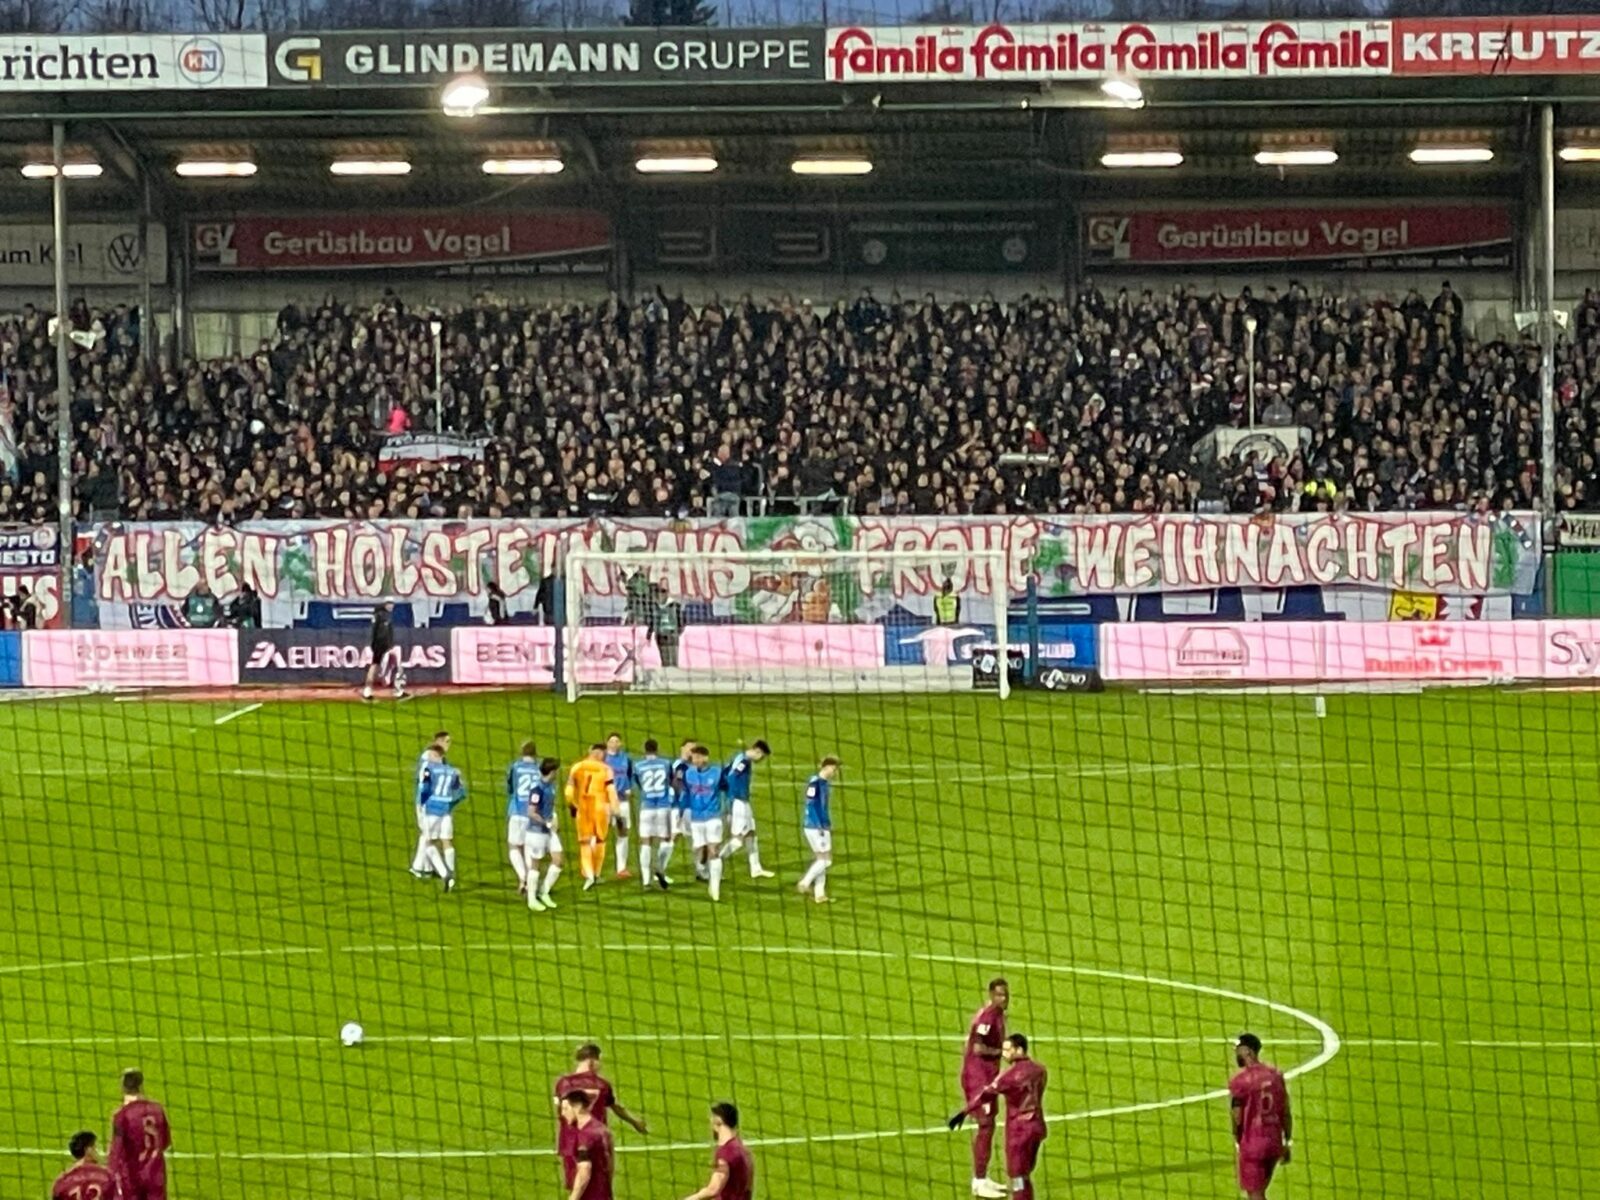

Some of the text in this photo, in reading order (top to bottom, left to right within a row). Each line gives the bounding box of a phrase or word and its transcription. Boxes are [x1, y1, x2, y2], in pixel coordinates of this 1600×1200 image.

[2, 45, 159, 80] richten
[345, 39, 810, 74] GLINDEMANN GRUPPE
[828, 22, 1389, 80] famila famila famila famila
[1402, 31, 1600, 62] KREUTZ
[263, 226, 511, 258] Gerüstbau Vogel
[1157, 219, 1409, 252] Gerüstbau Vogel
[40, 242, 83, 265] Kel
[101, 524, 281, 600] ALLEN
[854, 519, 1040, 598] FROHE
[1075, 521, 1490, 592] WEIHNACHTEN
[435, 775, 452, 796] 11
[585, 774, 593, 794] 1
[642, 769, 667, 792] 22
